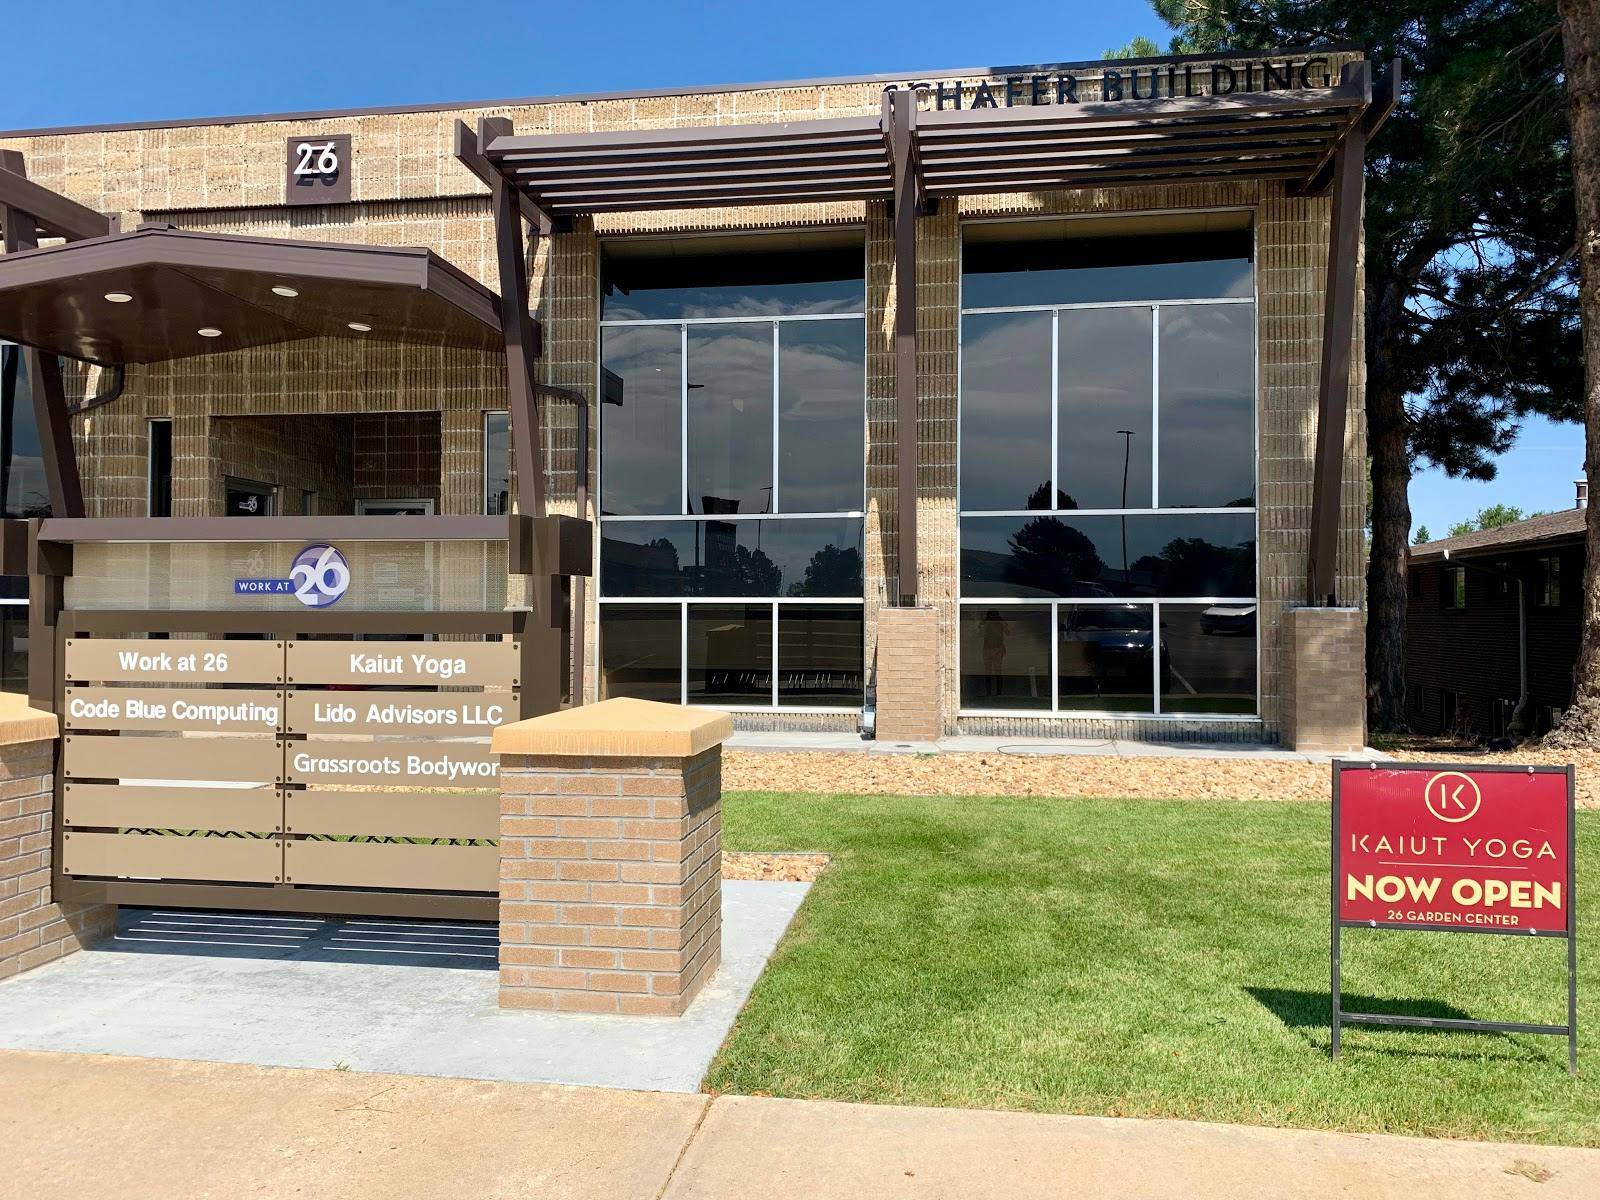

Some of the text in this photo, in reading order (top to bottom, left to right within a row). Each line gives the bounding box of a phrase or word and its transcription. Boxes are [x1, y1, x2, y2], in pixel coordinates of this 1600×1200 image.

[1103, 57, 1329, 102] BUILDING
[293, 142, 338, 175] 26
[238, 545, 351, 606] WORK AT 26
[118, 651, 228, 673] Work at 26
[350, 653, 467, 679] Kaiut Yoga
[70, 698, 279, 727] Code Blue Computing
[313, 703, 504, 725] Lido Advisors LLC
[293, 753, 500, 781] Grassroots Bodywor
[1351, 833, 1557, 860] KAIUT YOGA
[1347, 873, 1562, 910] NOW OPEN
[1387, 910, 1520, 926] 26 GARDEN CENTER
